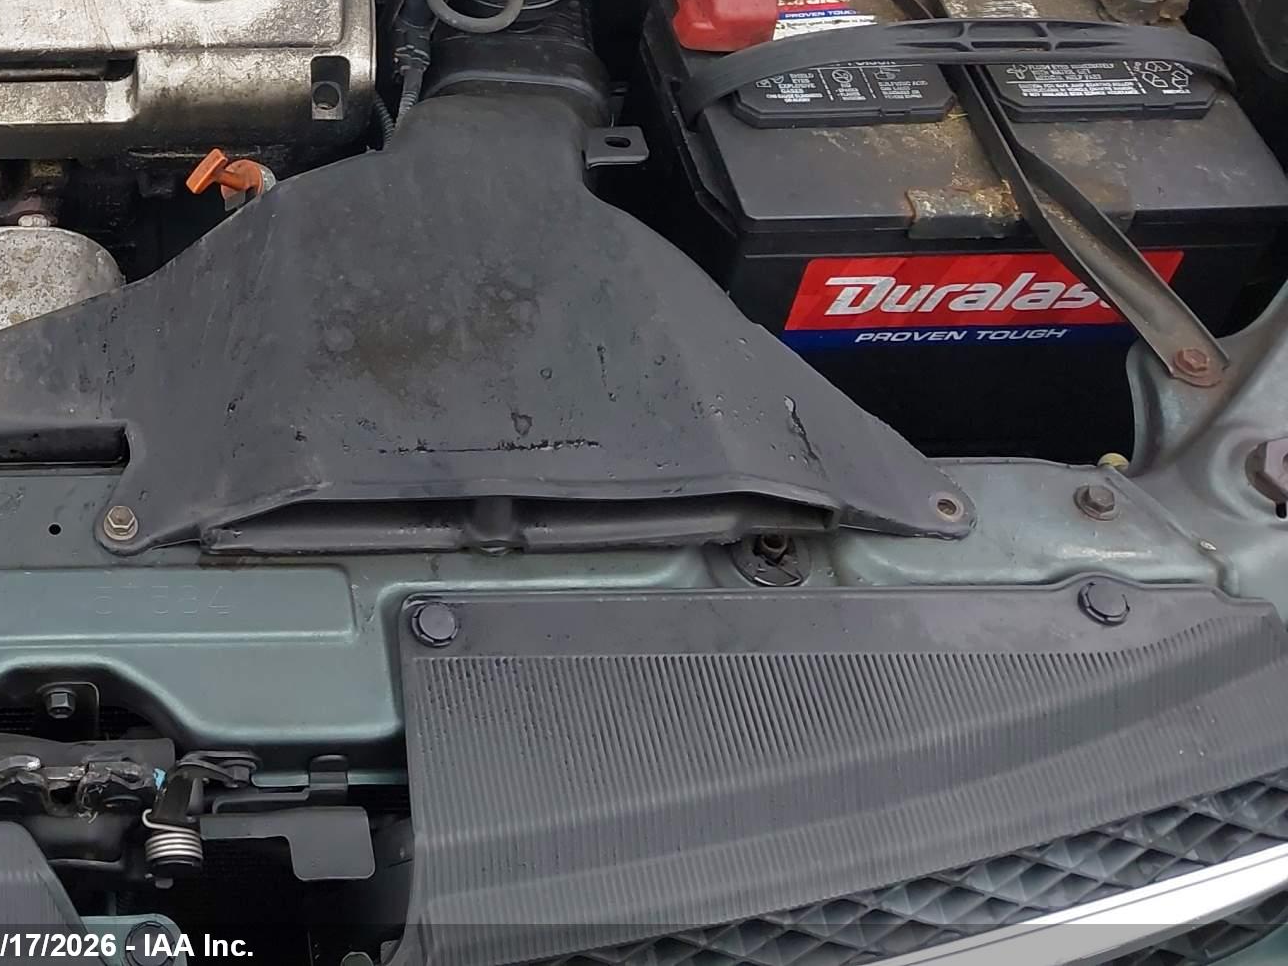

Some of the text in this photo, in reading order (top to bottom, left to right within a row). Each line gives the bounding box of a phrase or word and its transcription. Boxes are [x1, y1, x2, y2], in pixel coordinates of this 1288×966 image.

[824, 272, 1112, 316] Duralas
[854, 328, 1067, 343] PROVEN TOUGH
